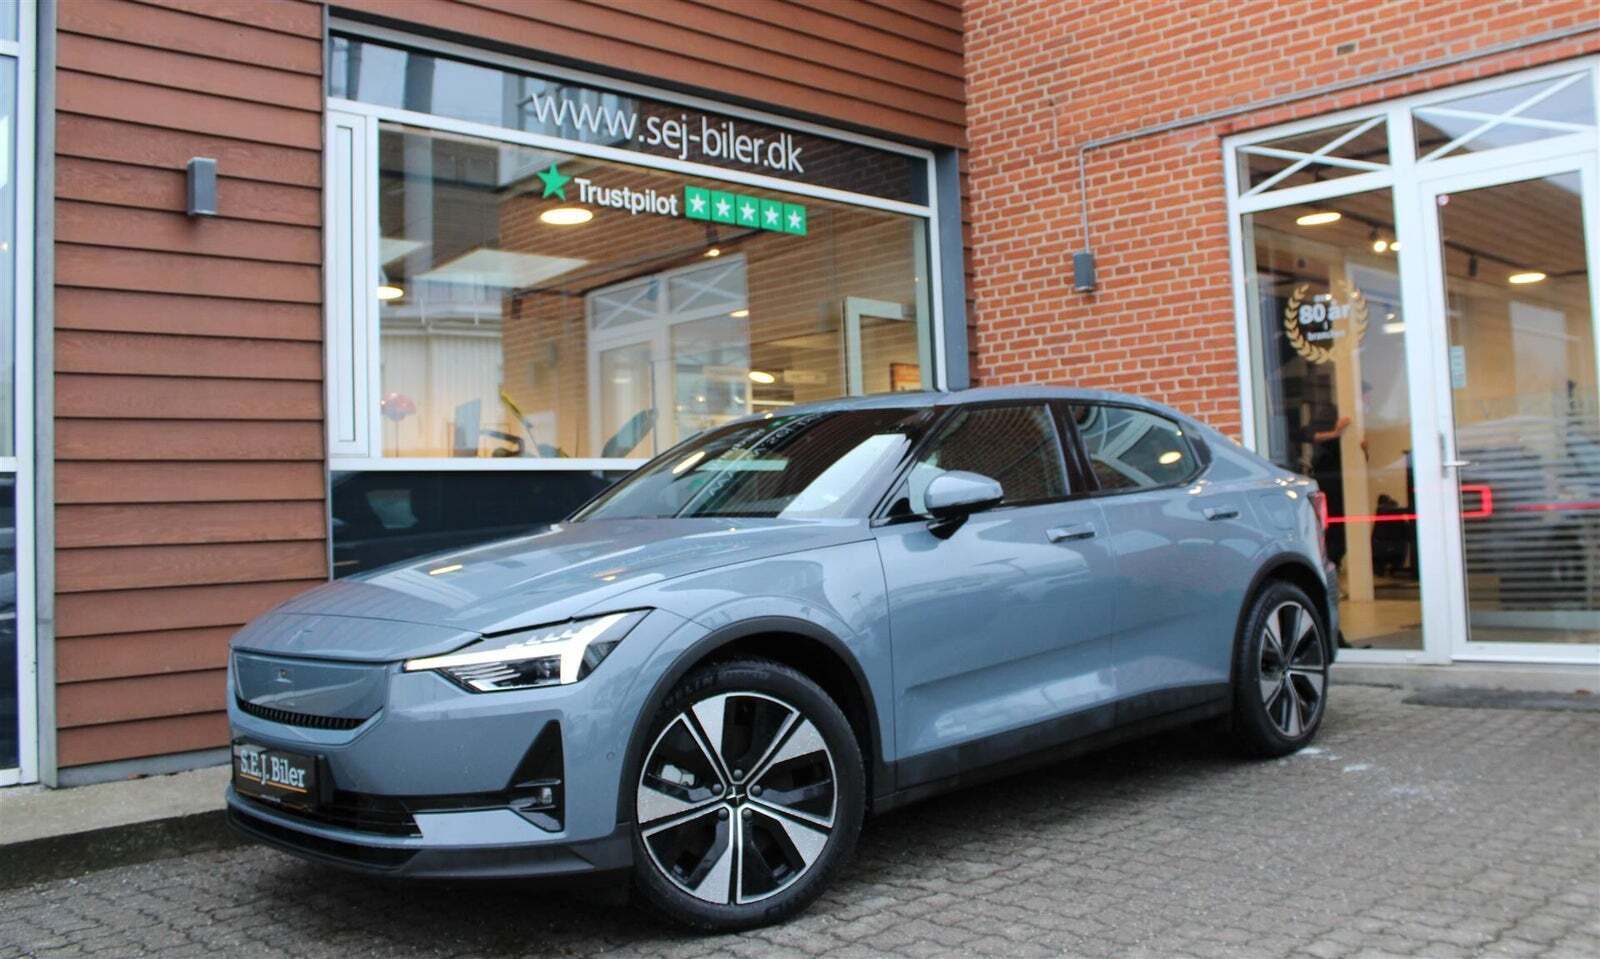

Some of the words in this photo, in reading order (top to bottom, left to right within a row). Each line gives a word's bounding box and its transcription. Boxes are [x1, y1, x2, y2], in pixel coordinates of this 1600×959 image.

[532, 93, 804, 173] www.sej-biler.dk
[574, 178, 678, 216] Trustpilot
[1299, 304, 1326, 324] 80
[240, 750, 269, 785] S.E.J.
[270, 756, 305, 788] Biler
